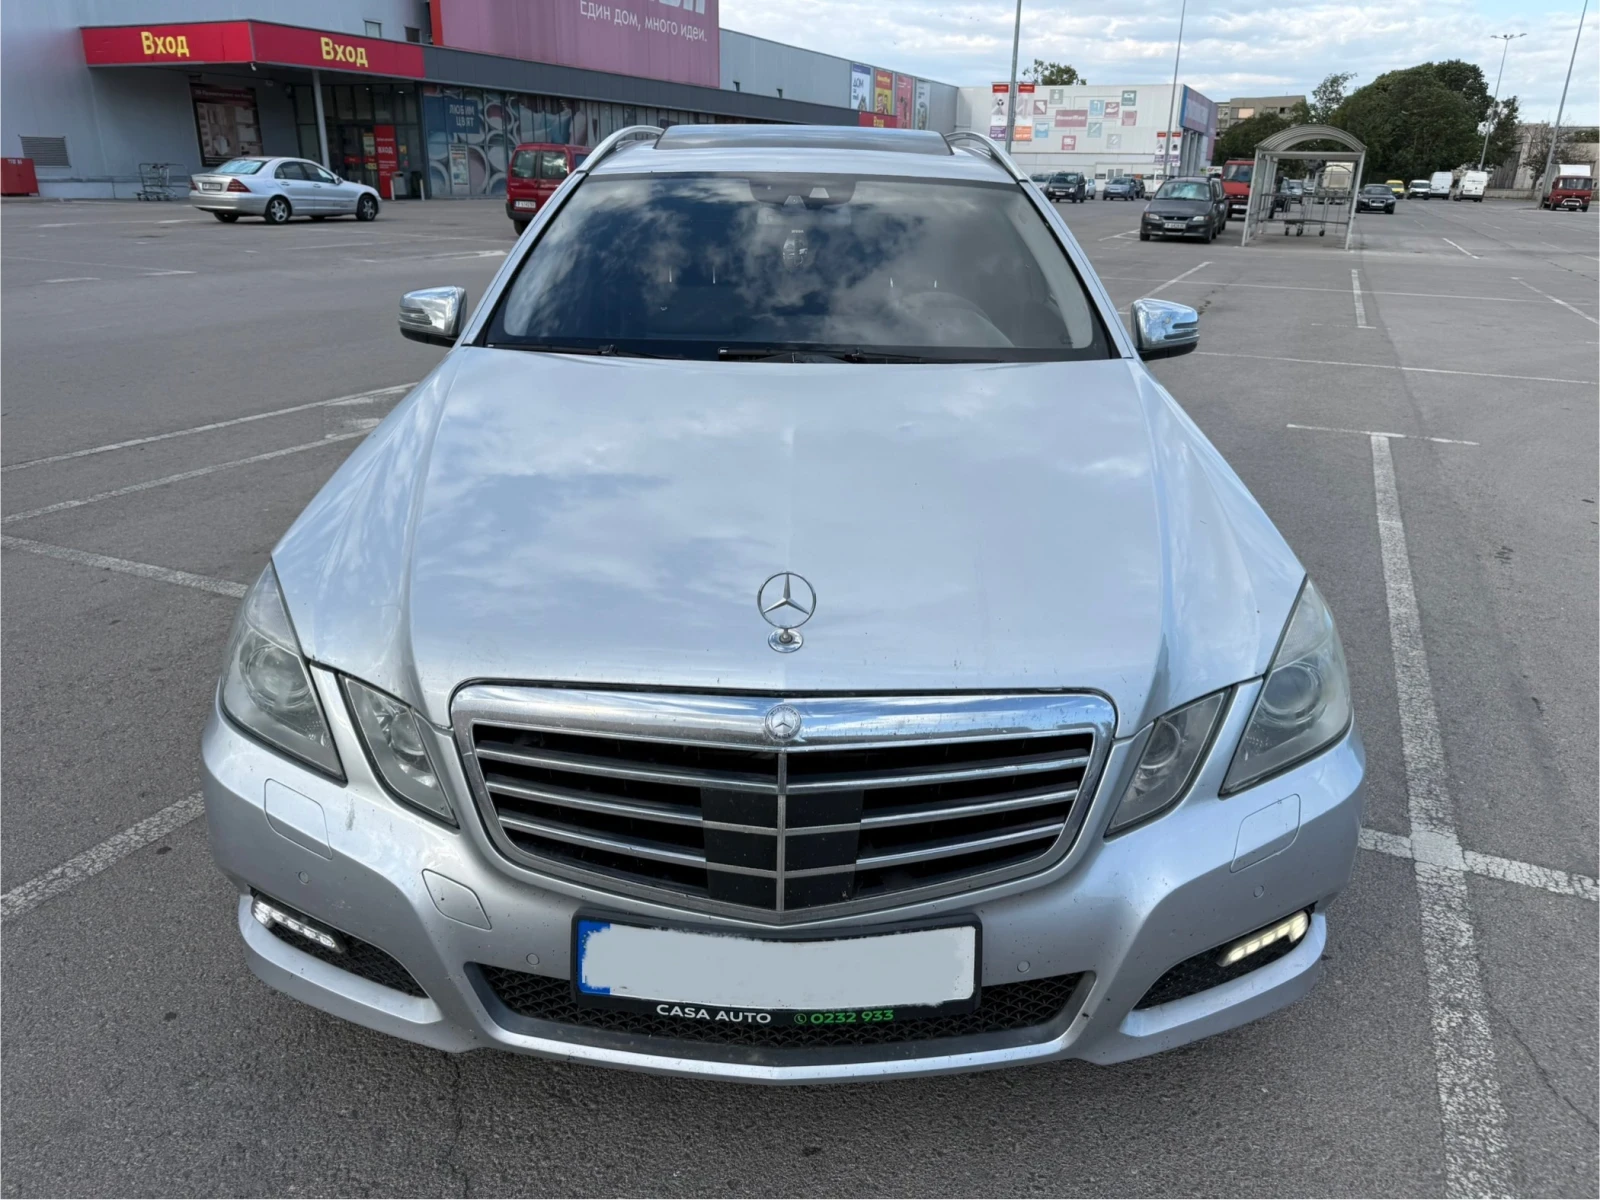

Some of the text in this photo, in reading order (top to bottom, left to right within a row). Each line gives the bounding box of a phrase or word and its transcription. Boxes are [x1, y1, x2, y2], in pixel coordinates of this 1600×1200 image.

[580, 0, 708, 42] Един дом, много идеи.
[140, 31, 190, 58] Вход
[320, 36, 369, 68] Вход
[656, 1004, 772, 1023] CASA AUTO
[810, 1010, 894, 1024] 0232 933
